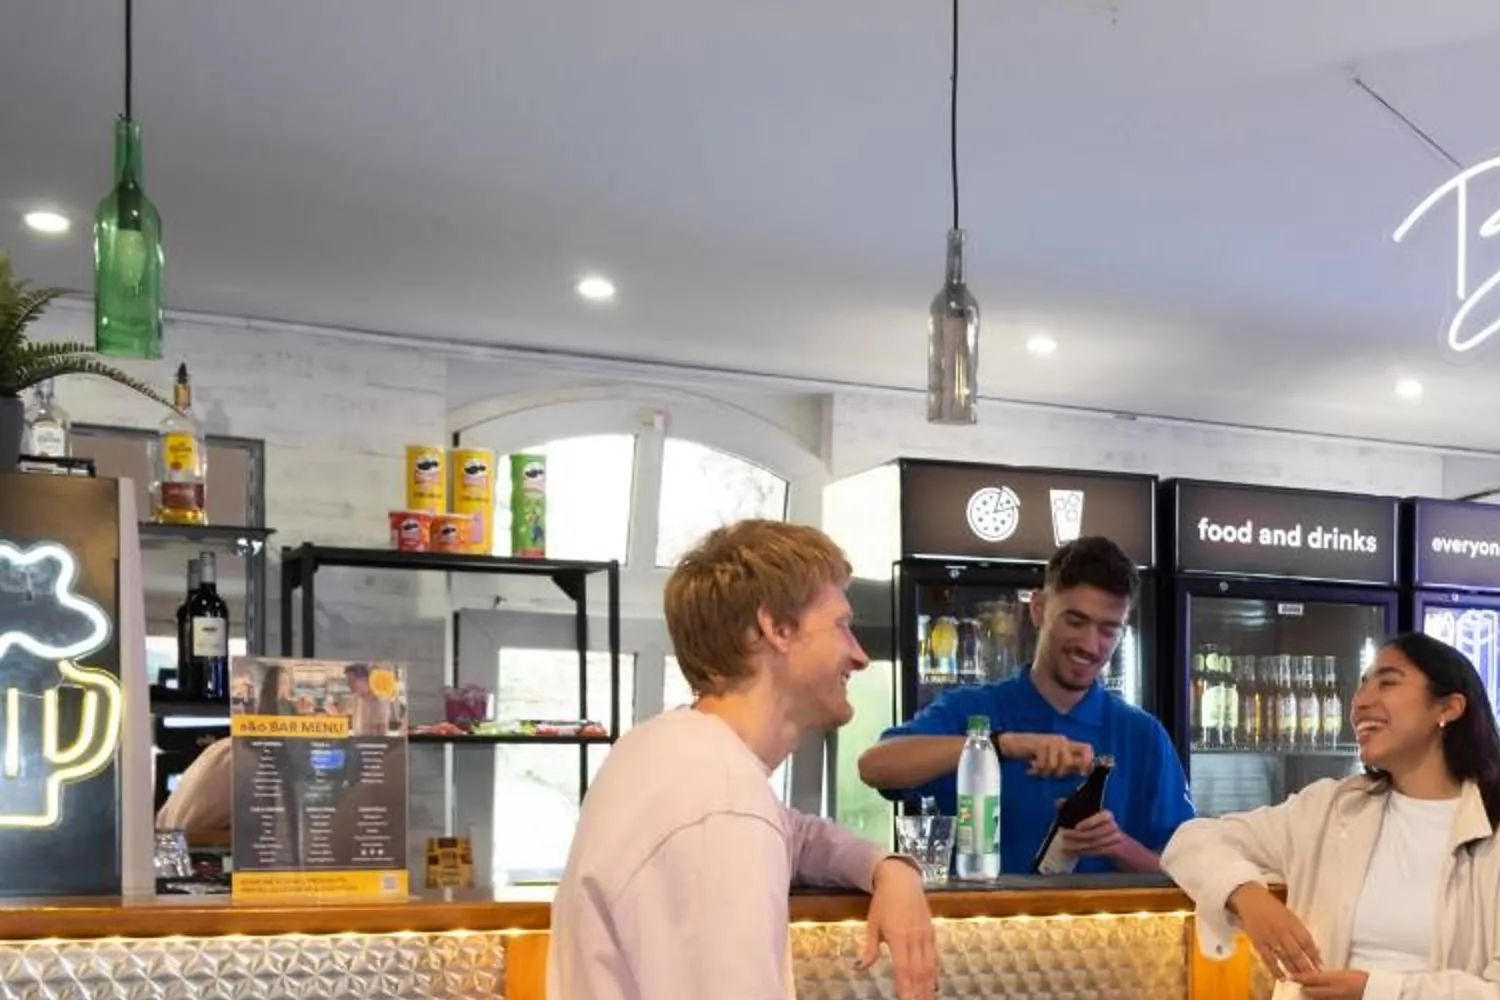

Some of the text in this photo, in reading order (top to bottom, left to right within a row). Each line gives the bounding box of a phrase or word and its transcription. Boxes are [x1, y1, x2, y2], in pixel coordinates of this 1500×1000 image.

[1197, 516, 1377, 553] food and drinks
[270, 721, 298, 733] BAR
[301, 721, 343, 734] MENU
